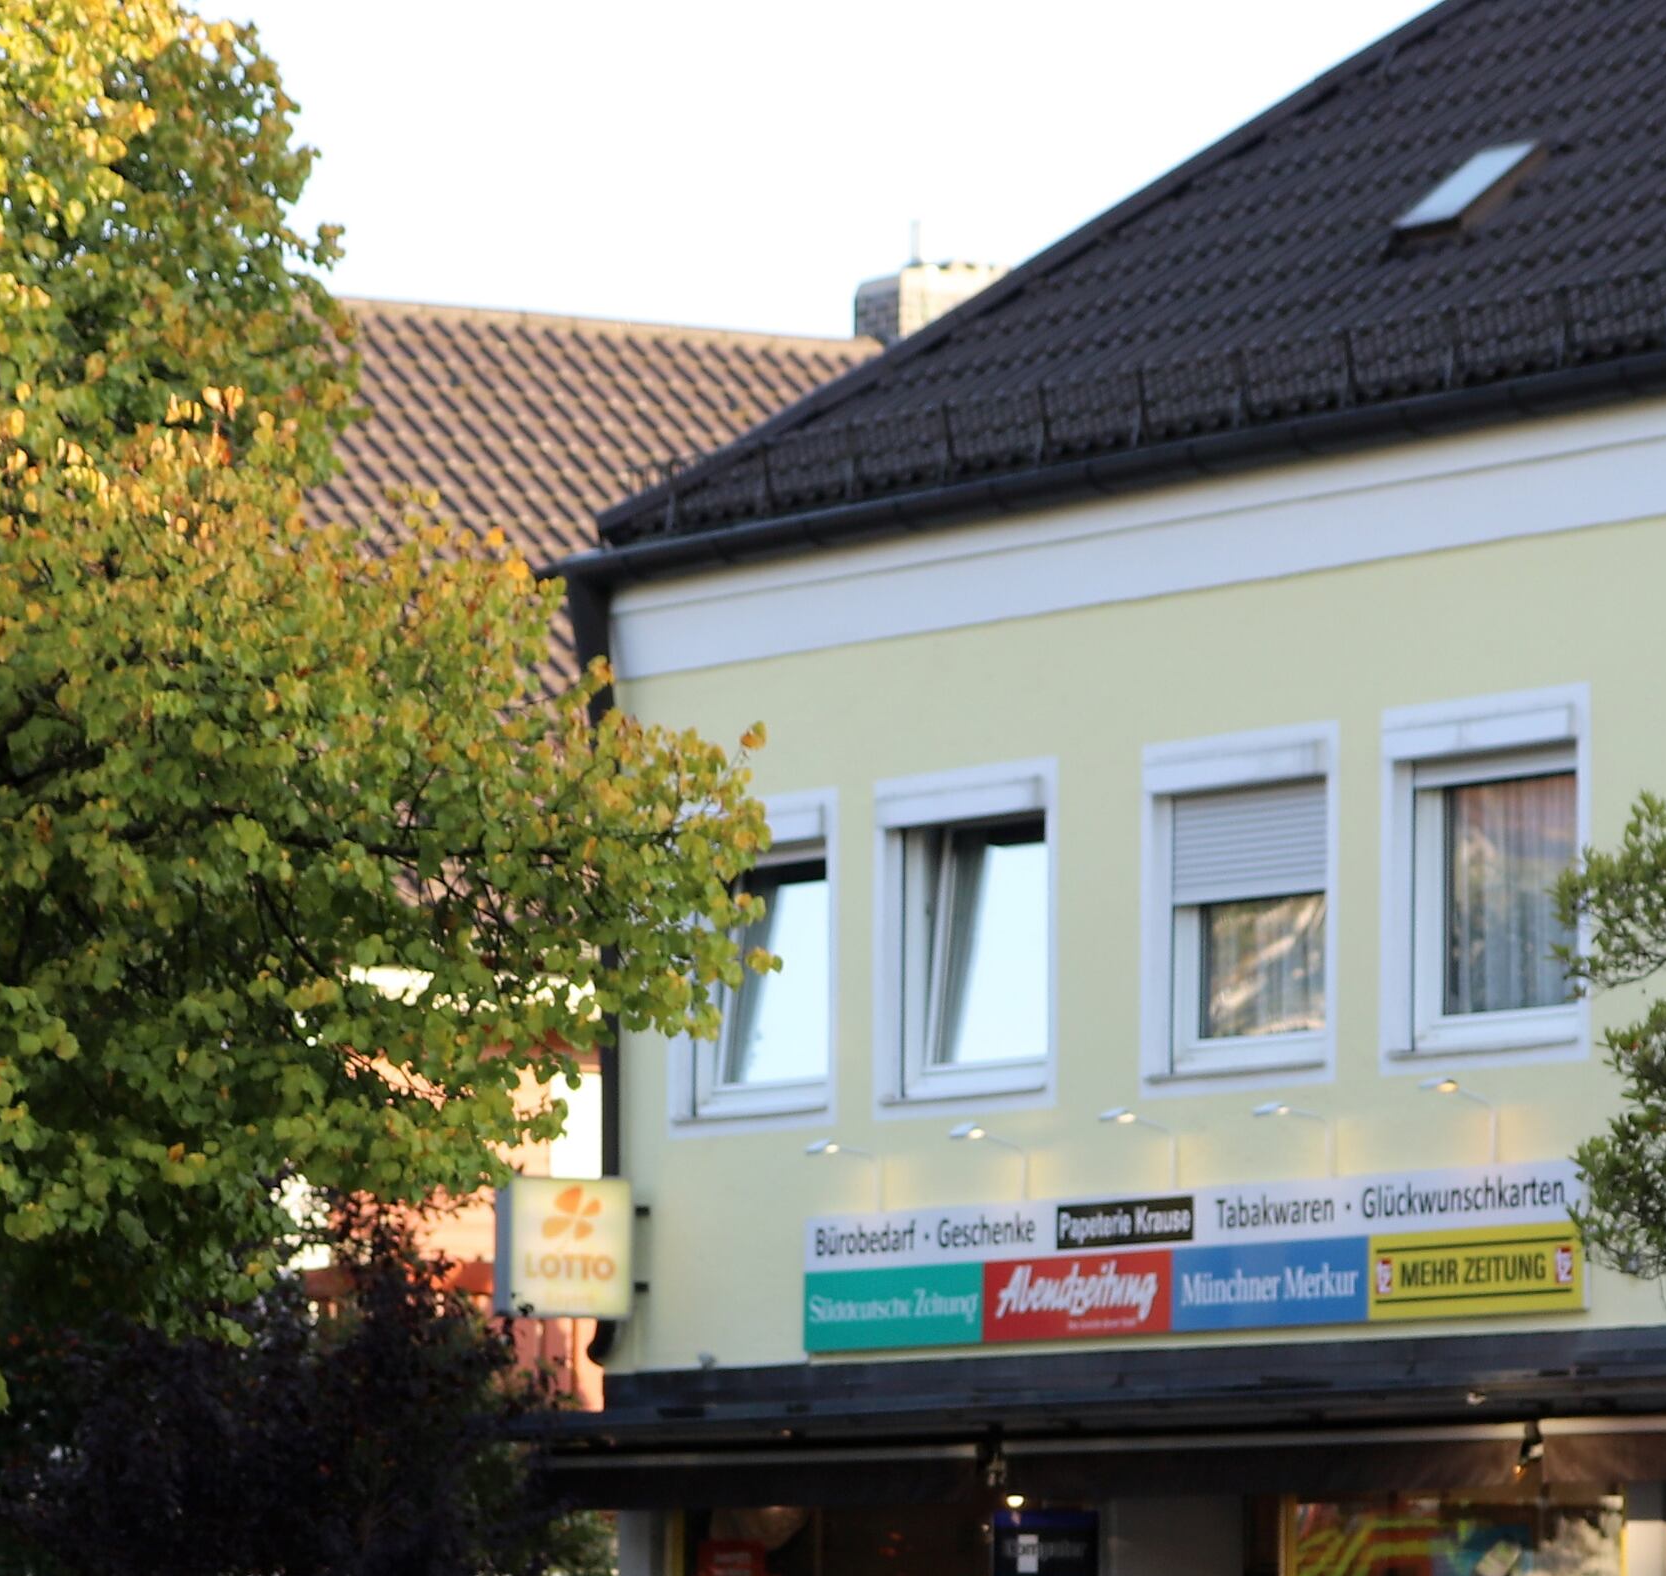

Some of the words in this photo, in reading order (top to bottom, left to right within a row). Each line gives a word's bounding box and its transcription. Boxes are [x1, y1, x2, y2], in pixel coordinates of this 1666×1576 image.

[1057, 1208, 1132, 1241] Papeterie
[1134, 1204, 1192, 1234] Krause
[1216, 1197, 1335, 1229] Tabakwaren
[1362, 1177, 1566, 1219] Glückwunschkarten
[815, 1219, 915, 1256] Bürobedarf
[937, 1212, 1036, 1249] Geschenke
[524, 1252, 616, 1281] LOTTO
[1181, 1268, 1280, 1306] Münchner
[1282, 1263, 1359, 1299] Merkur
[1400, 1260, 1459, 1288] MEHR
[1463, 1253, 1547, 1284] ZEITUNG
[808, 1293, 911, 1324] Süddeutsche
[914, 1288, 979, 1322] Zeitung
[995, 1260, 1159, 1321] Abendzeitung
